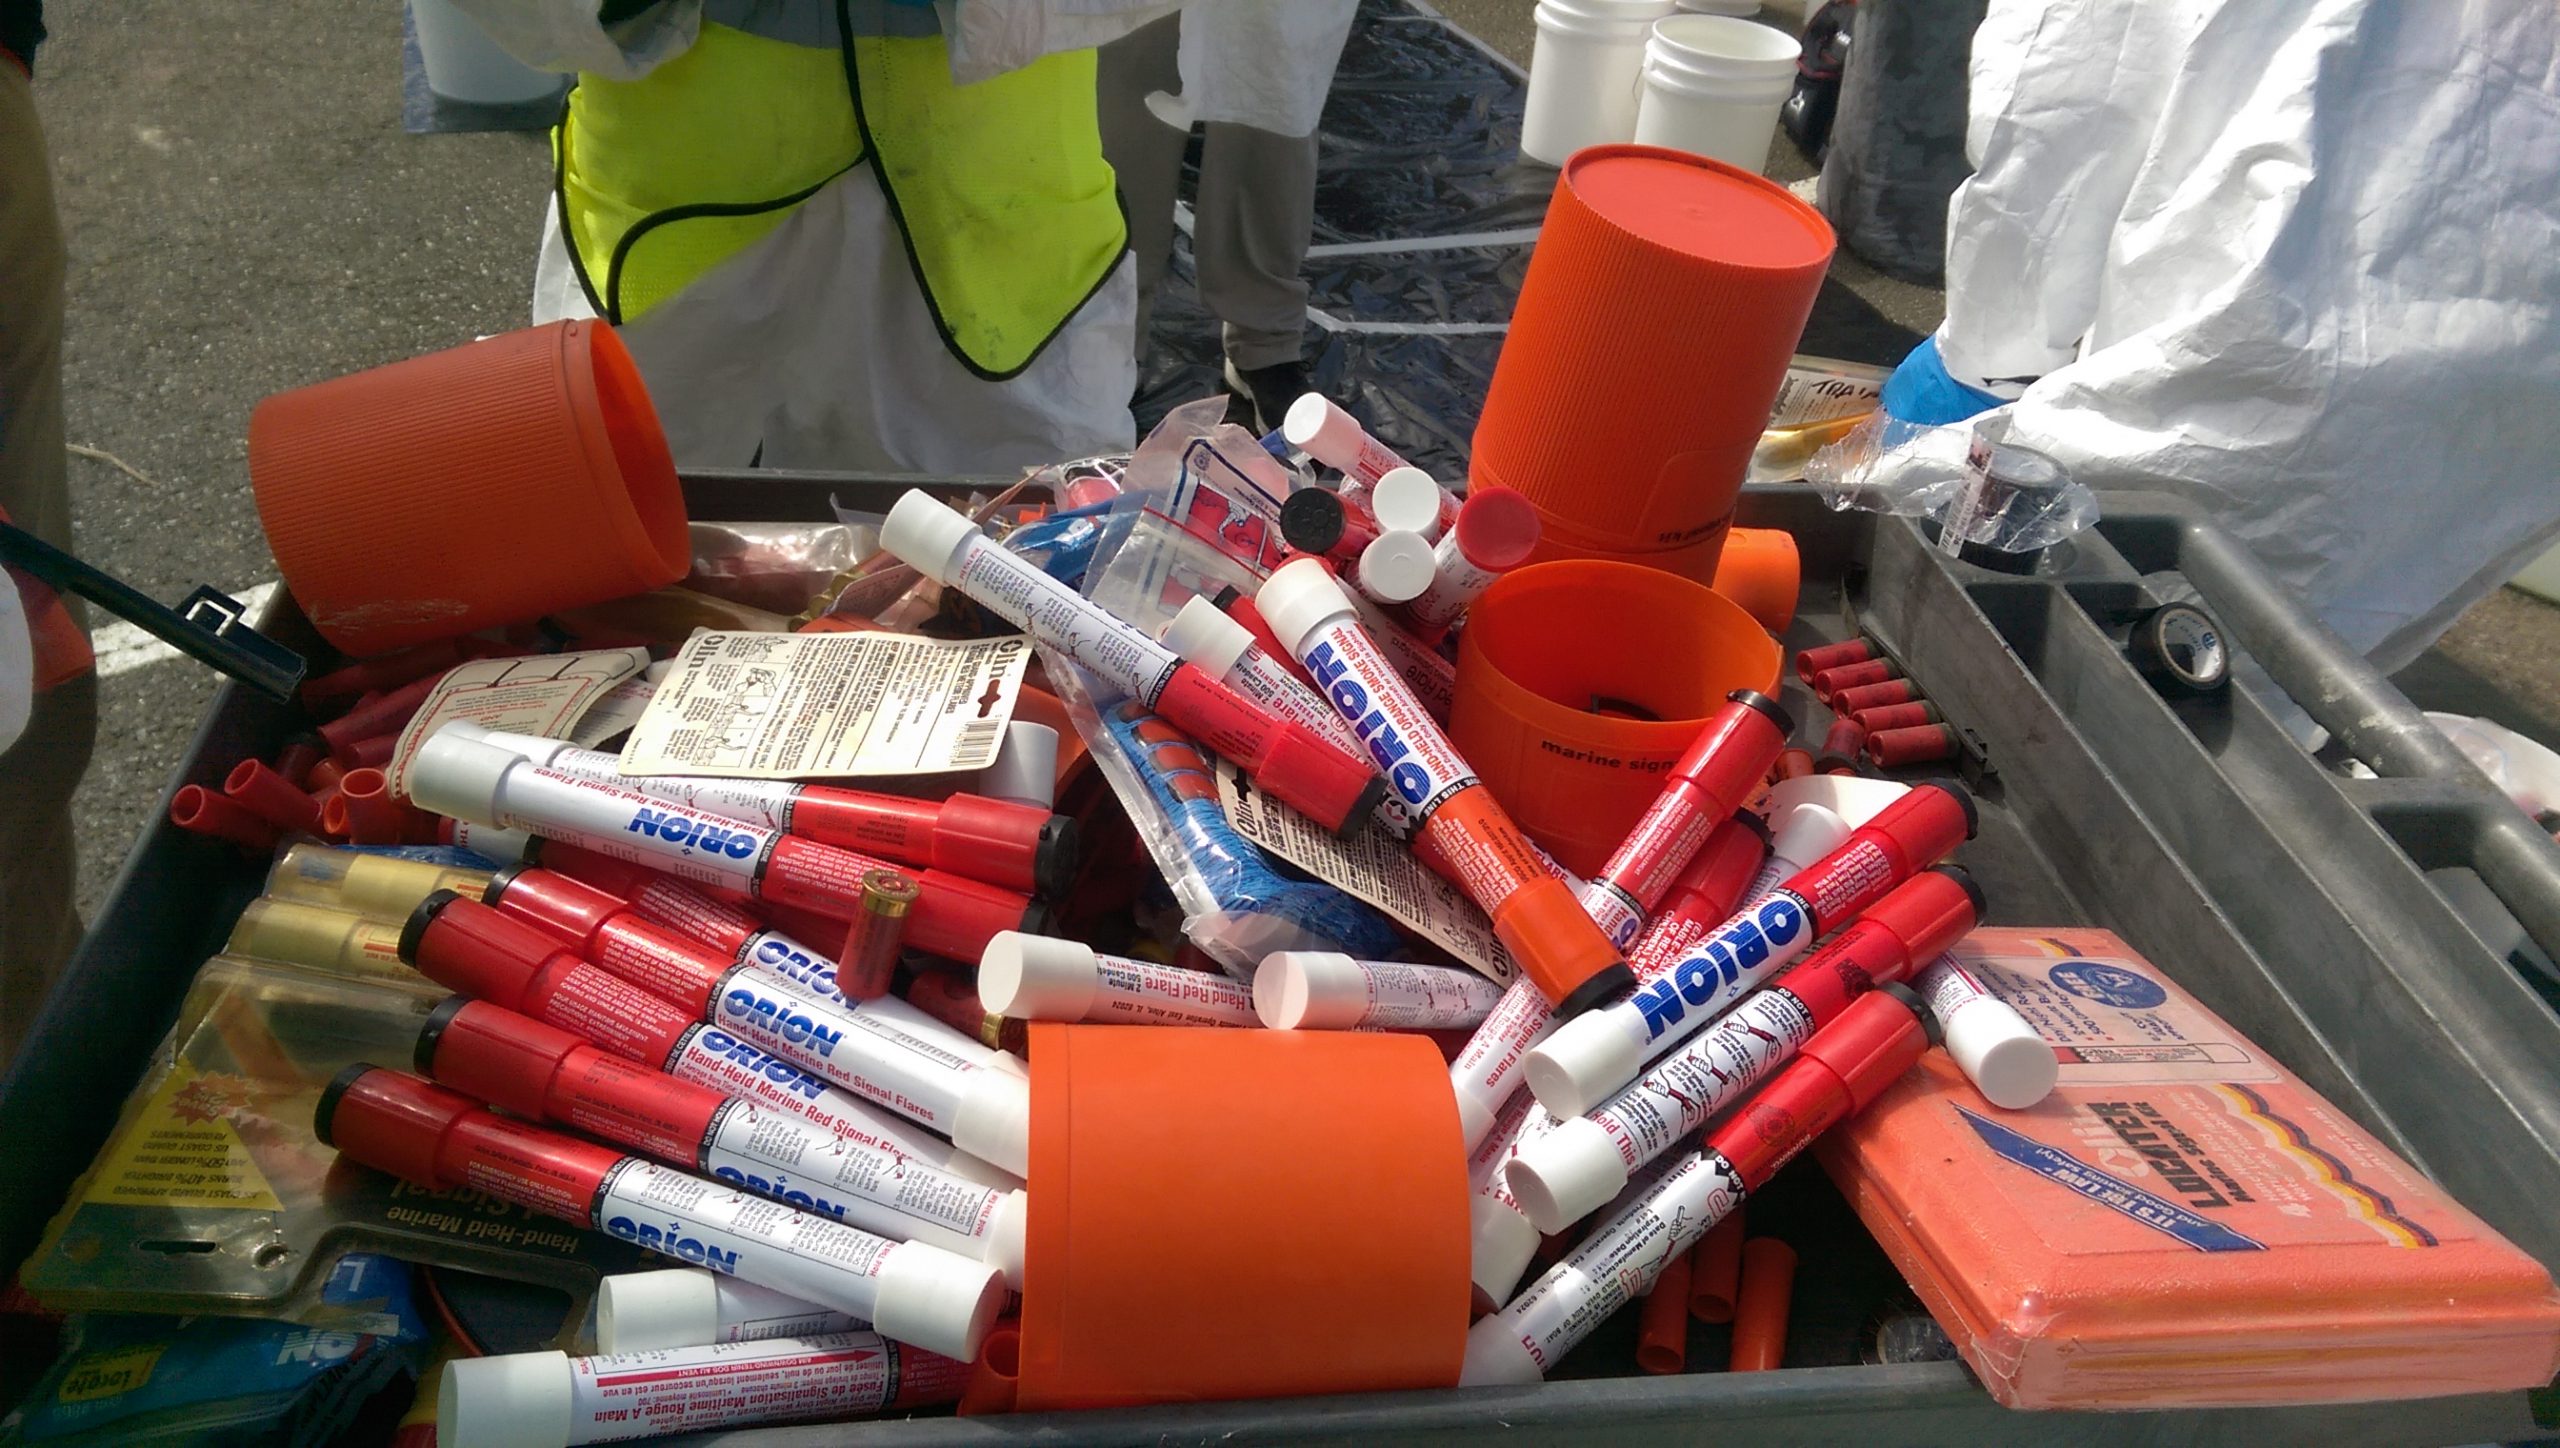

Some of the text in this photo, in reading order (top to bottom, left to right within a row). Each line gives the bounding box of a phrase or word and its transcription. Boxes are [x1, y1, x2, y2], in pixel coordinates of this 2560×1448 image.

[1345, 627, 1368, 654] Sighted
[988, 634, 1023, 685] Olin
[1367, 655, 1386, 678] Vessel
[1234, 660, 1275, 698] 500 Candela
[1239, 676, 1263, 699] Minute
[1251, 662, 1280, 690] SIGHTED
[1260, 695, 1269, 704] 2
[1288, 695, 1315, 720] VESSEL
[1329, 626, 1453, 784] HAND-HELD ORANGE SMOKE SIGNAL
[1388, 683, 1410, 709] Aircraft
[1304, 641, 1430, 804] ORION
[1406, 706, 1422, 725] When
[1418, 721, 1433, 738] Only
[1325, 727, 1361, 760] AIRCRAFT
[1428, 735, 1453, 764] Daytime
[1540, 739, 1621, 767] marine
[1447, 760, 1462, 776] Use
[533, 765, 768, 837] Hand-Held Marine Red Signal Flares
[624, 807, 757, 859] ORION
[1646, 919, 1681, 966] OF REACH
[1125, 971, 1142, 981] 500
[1631, 892, 1801, 1039] ORION
[1107, 975, 1246, 1010] Hand Red Flare 2 Minute
[1777, 984, 1808, 1015] DO NOT
[724, 989, 844, 1057] ORION
[702, 1030, 828, 1099] ORION
[1484, 1015, 1544, 1091] Signal Flares
[714, 1014, 935, 1122] Hand-Held Marine Red Signal Flares
[684, 1044, 755, 1091] Hand-Held
[755, 1080, 804, 1114] Marine
[805, 1105, 834, 1129] Red
[832, 1118, 879, 1152] Signal
[1587, 1104, 1644, 1167] Hold This
[1642, 1182, 1666, 1205] Signal
[2051, 1162, 2102, 1198] LAW
[1615, 1200, 1645, 1229] Products
[2134, 1188, 2175, 1217] Good
[385, 1204, 578, 1254] Hand-Held Marine
[2135, 1201, 2176, 1233] IT'S
[608, 1216, 739, 1274] ORION
[1583, 1224, 1617, 1257] Operation
[1608, 1212, 1659, 1260] Expiration Date
[1567, 1252, 1585, 1270] East
[1600, 1276, 1618, 1293] HOLD
[1515, 1293, 1538, 1315] 62024
[1570, 1305, 1586, 1320] SIDE
[1584, 1290, 1602, 1308] OVER
[676, 1368, 698, 1376] VENT
[736, 1371, 779, 1384] seulement
[802, 1368, 812, 1377] de
[826, 1363, 842, 1376] jour
[602, 1388, 619, 1397] vue
[634, 1385, 648, 1395] est
[748, 1385, 829, 1405] Signalisation
[830, 1385, 846, 1396] de
[593, 1408, 628, 1424] Main
[631, 1407, 642, 1419] A
[644, 1400, 686, 1418] Rouge
[688, 1396, 746, 1413] Maritime
